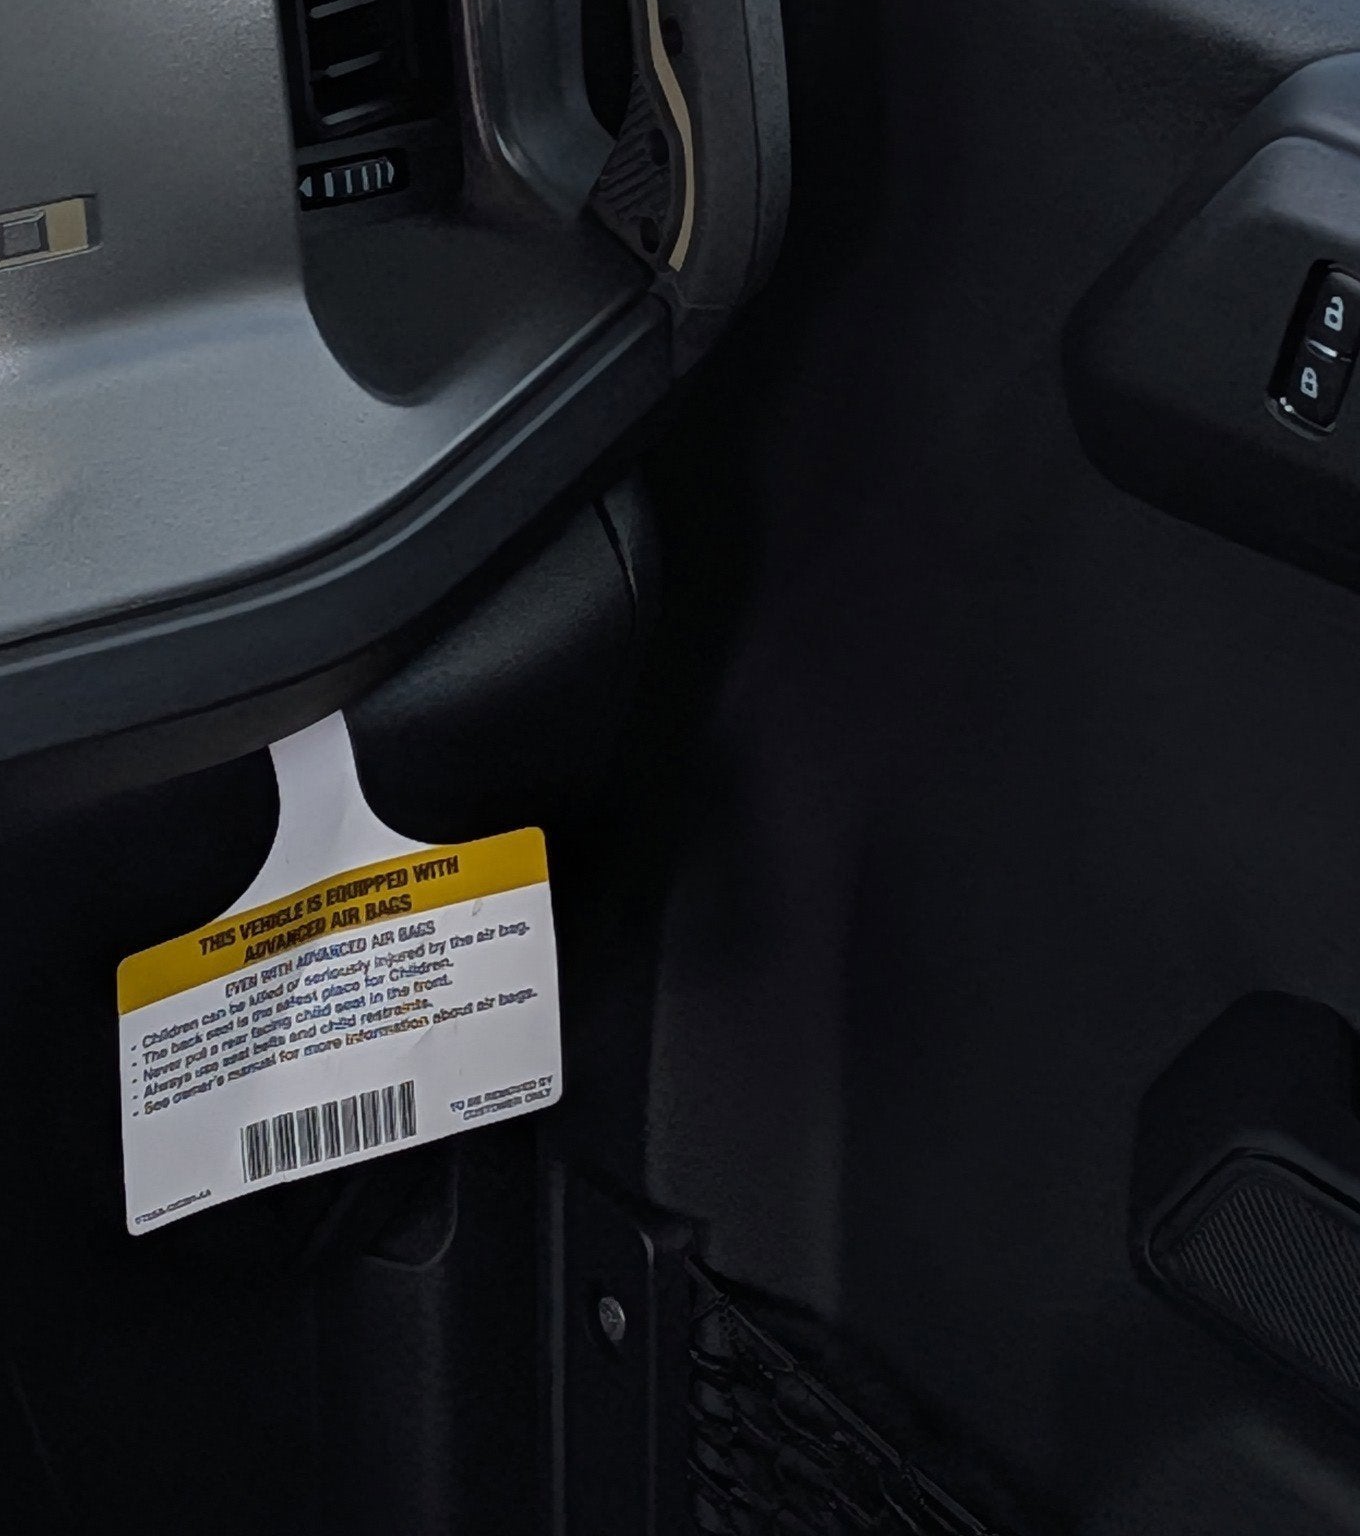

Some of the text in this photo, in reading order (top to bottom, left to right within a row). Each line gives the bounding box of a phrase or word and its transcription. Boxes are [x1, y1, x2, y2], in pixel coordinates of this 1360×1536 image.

[198, 855, 460, 956] THIS VEHICLE IS EQUIPPED WITH
[243, 893, 413, 964] ADVANCED AIR BAGS
[371, 930, 395, 950] AIR
[398, 920, 436, 943] BAGS
[142, 921, 531, 1049] Children can be killed or seriously injured by the air bag.
[142, 1047, 168, 1065] The
[171, 1034, 203, 1054] back
[206, 1020, 234, 1041] seat
[237, 1016, 249, 1028] is
[321, 980, 360, 1002] place
[364, 974, 386, 988] for
[389, 958, 454, 982] Children.
[143, 1058, 182, 1082] Never
[185, 1047, 207, 1069] put
[221, 1033, 249, 1051] rear
[251, 1016, 292, 1039] facing
[295, 1002, 332, 1024] child
[335, 995, 366, 1014] seat
[369, 992, 384, 1006] in
[387, 986, 410, 1000] the
[143, 1096, 171, 1115] See
[172, 1075, 225, 1104] owner's
[278, 1048, 301, 1064] for
[303, 1037, 343, 1056] more
[345, 1015, 430, 1046] information
[432, 1002, 474, 1025] about
[477, 996, 496, 1012] air
[499, 988, 538, 1006] bags.
[143, 1072, 192, 1099] Always
[289, 1024, 317, 1043] and
[320, 1014, 356, 1035] child
